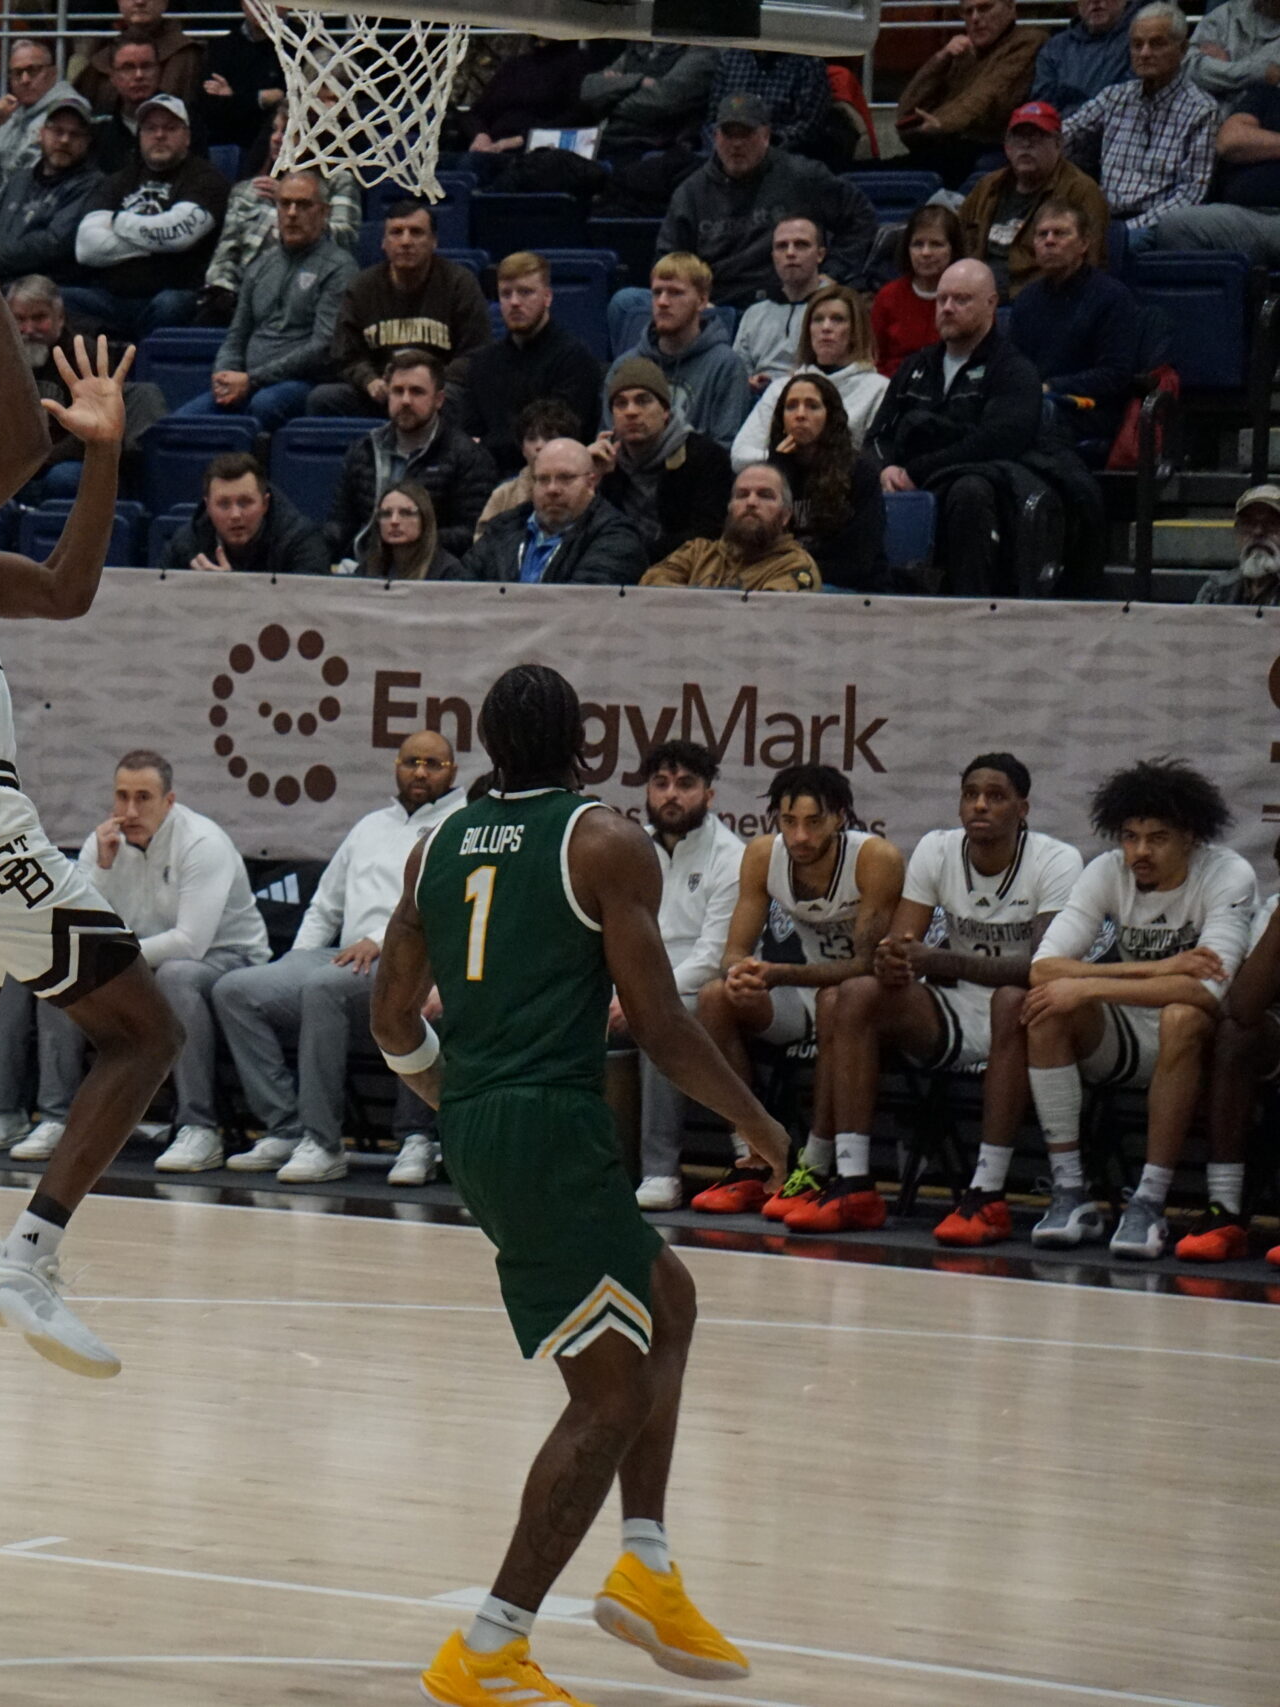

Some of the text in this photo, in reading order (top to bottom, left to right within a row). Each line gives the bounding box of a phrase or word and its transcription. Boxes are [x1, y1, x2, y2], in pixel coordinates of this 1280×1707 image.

[371, 669, 890, 788] EngyMark
[459, 823, 525, 856] BILLUPS
[464, 865, 497, 981] 1
[819, 934, 856, 960] 23
